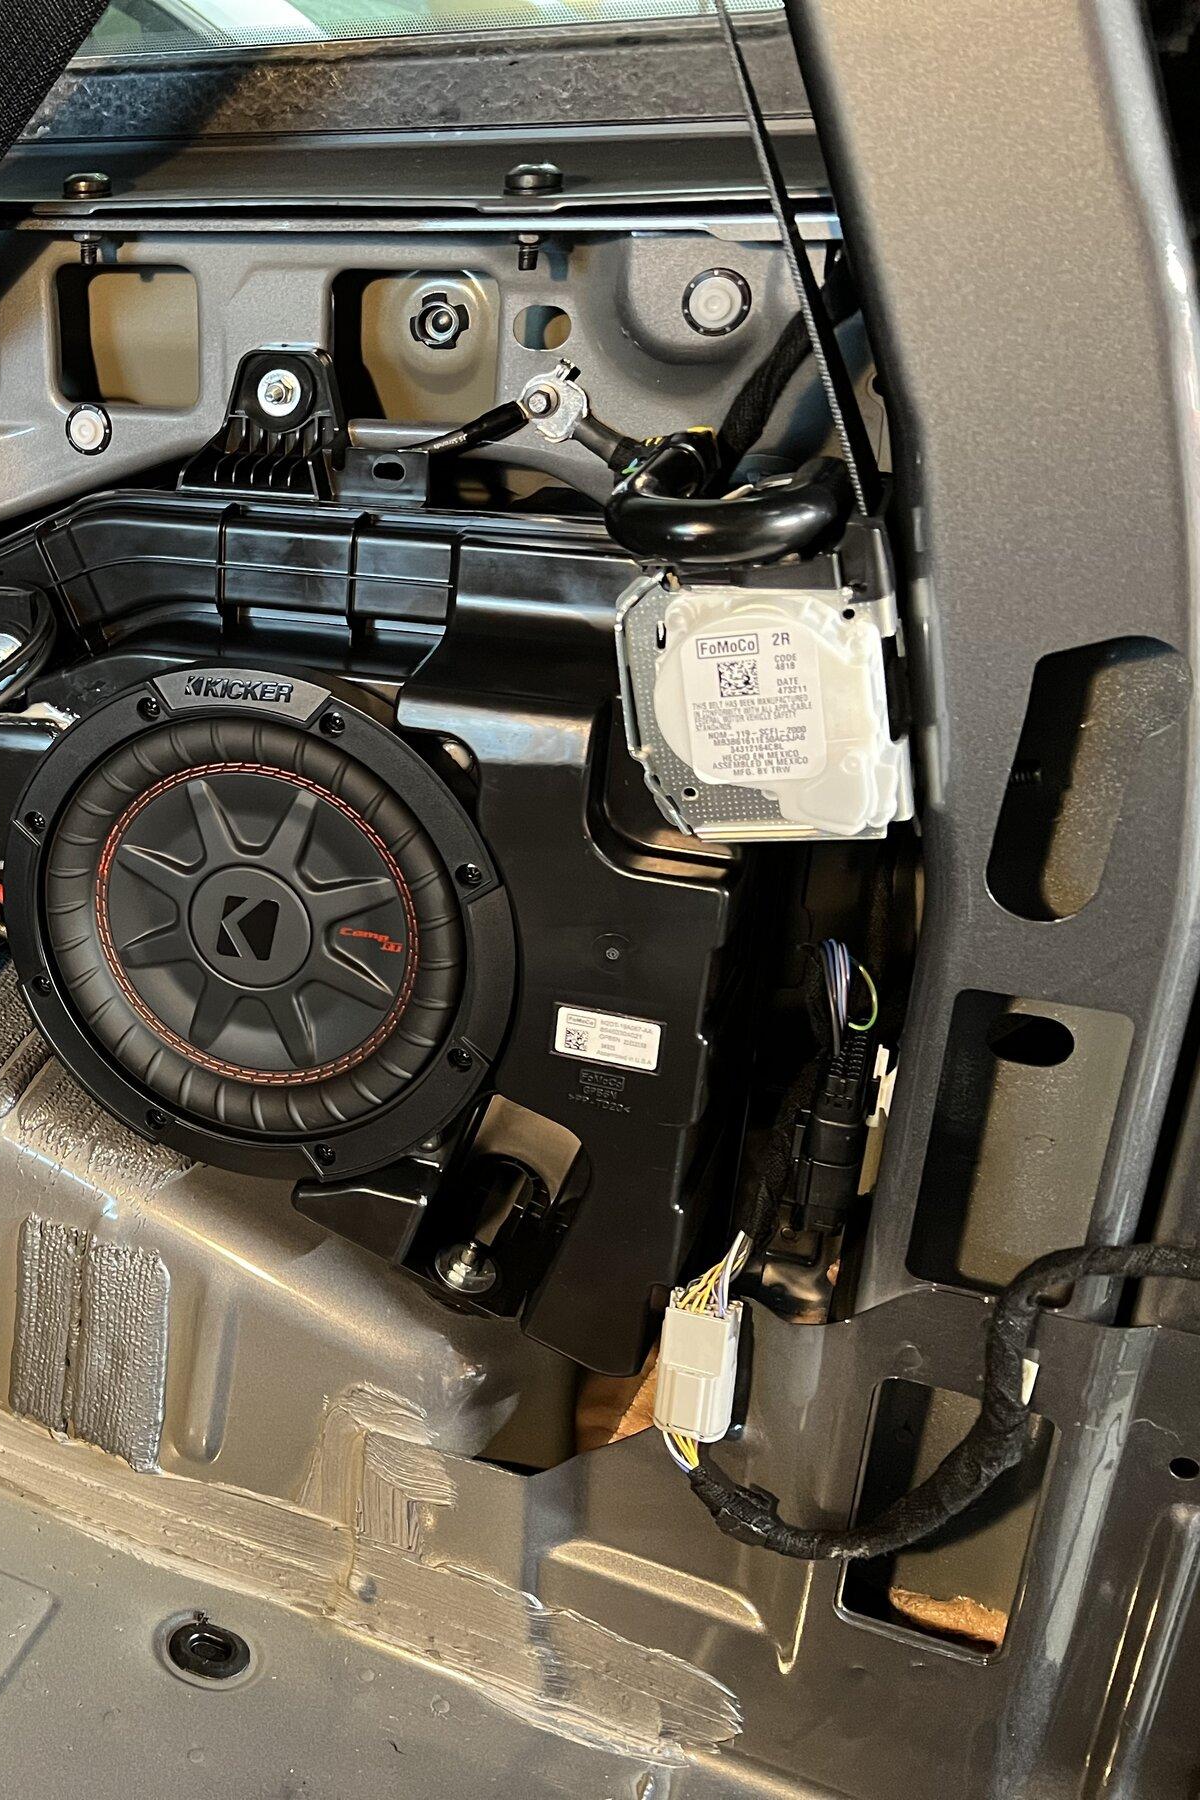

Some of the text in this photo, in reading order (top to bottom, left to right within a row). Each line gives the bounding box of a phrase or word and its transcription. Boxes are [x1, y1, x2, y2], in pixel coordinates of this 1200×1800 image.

[772, 633, 790, 646] 2R
[700, 639, 756, 655] FoMoCo
[774, 654, 797, 663] CODE
[777, 677, 798, 687] DATE
[204, 676, 293, 703] KICKER
[722, 749, 799, 762] HECHO EN MEXICO
[712, 760, 762, 769] ASSEMBLED
[776, 756, 808, 765] MEXICO
[771, 766, 791, 774] TRW
